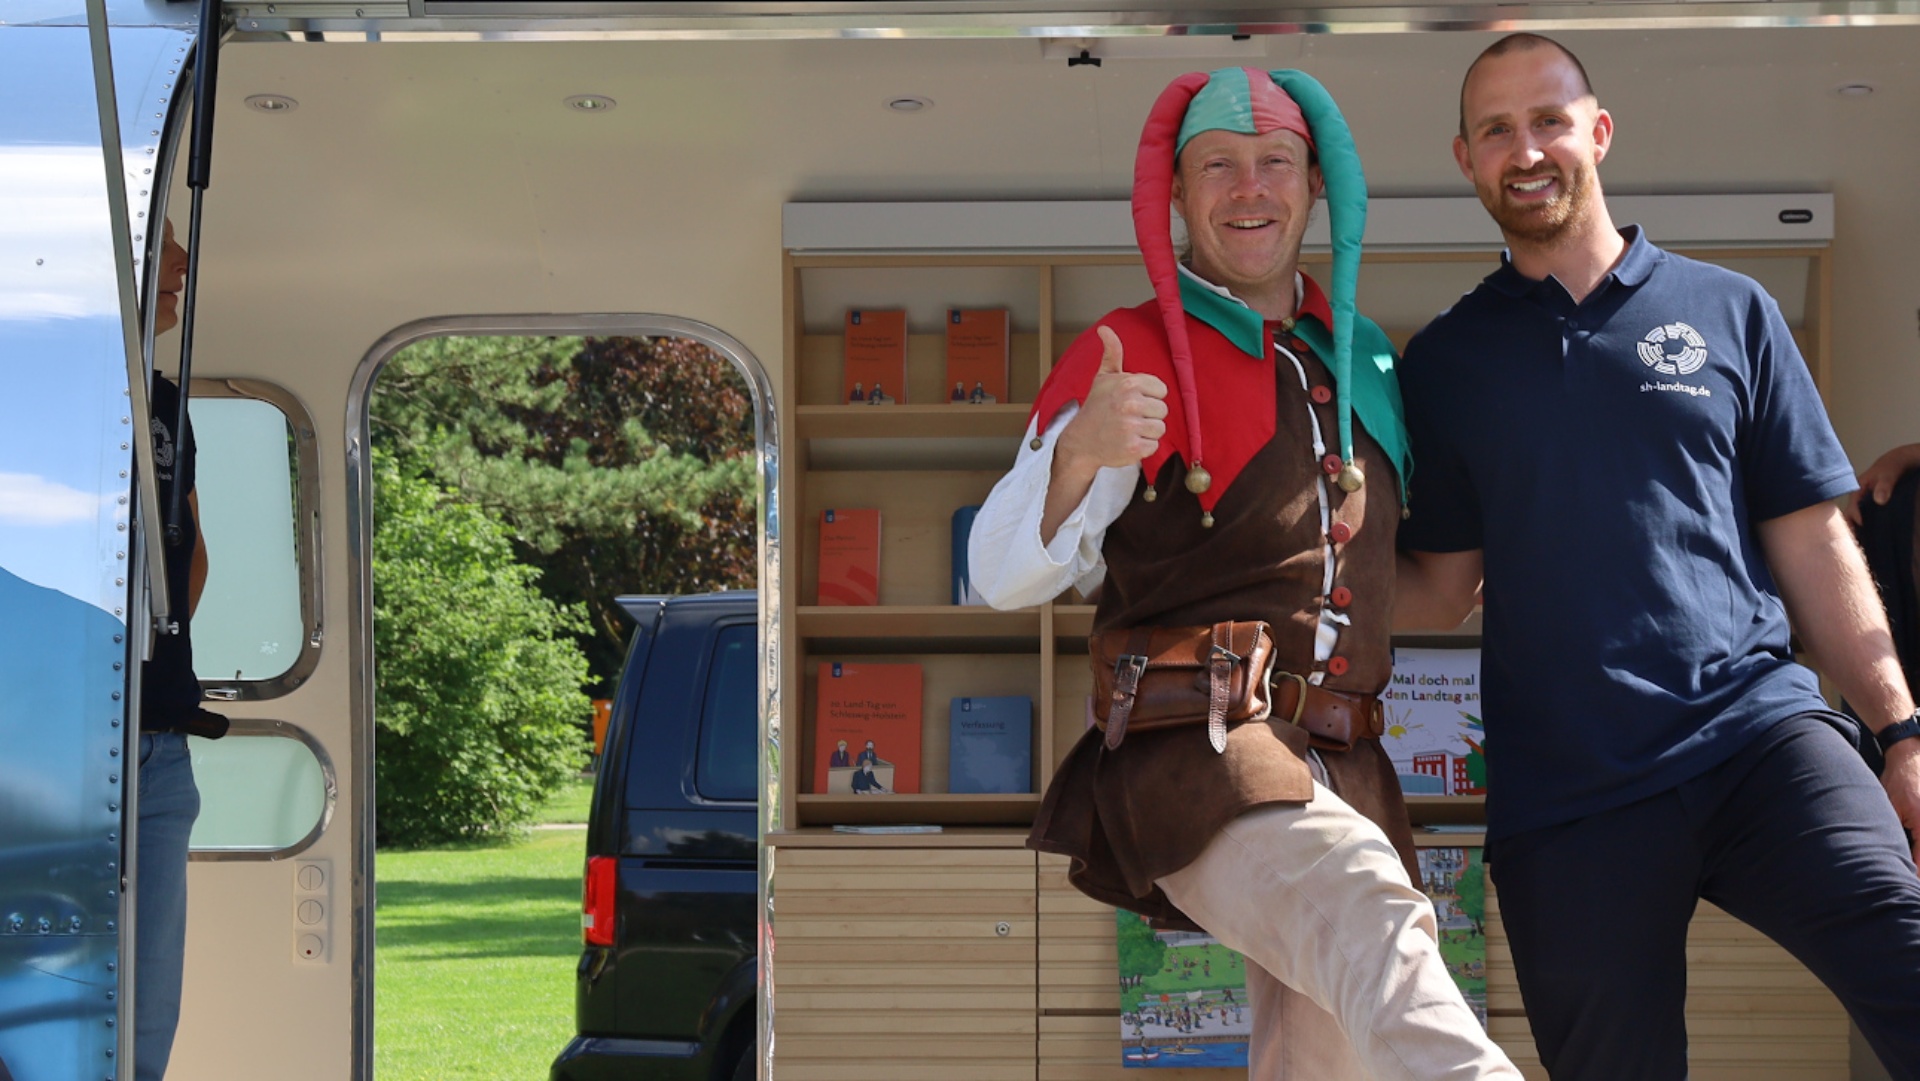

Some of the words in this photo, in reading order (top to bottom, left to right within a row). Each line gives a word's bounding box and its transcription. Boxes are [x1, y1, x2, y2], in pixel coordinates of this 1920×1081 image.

[1640, 381, 1711, 398] sh-landtag.de
[1392, 674, 1415, 685] Mal
[1418, 674, 1449, 686] doch
[1452, 674, 1475, 686] mal
[1385, 688, 1409, 700] den
[1411, 690, 1462, 704] Landtag
[1464, 692, 1479, 701] an
[961, 720, 1006, 730] Verfassung
